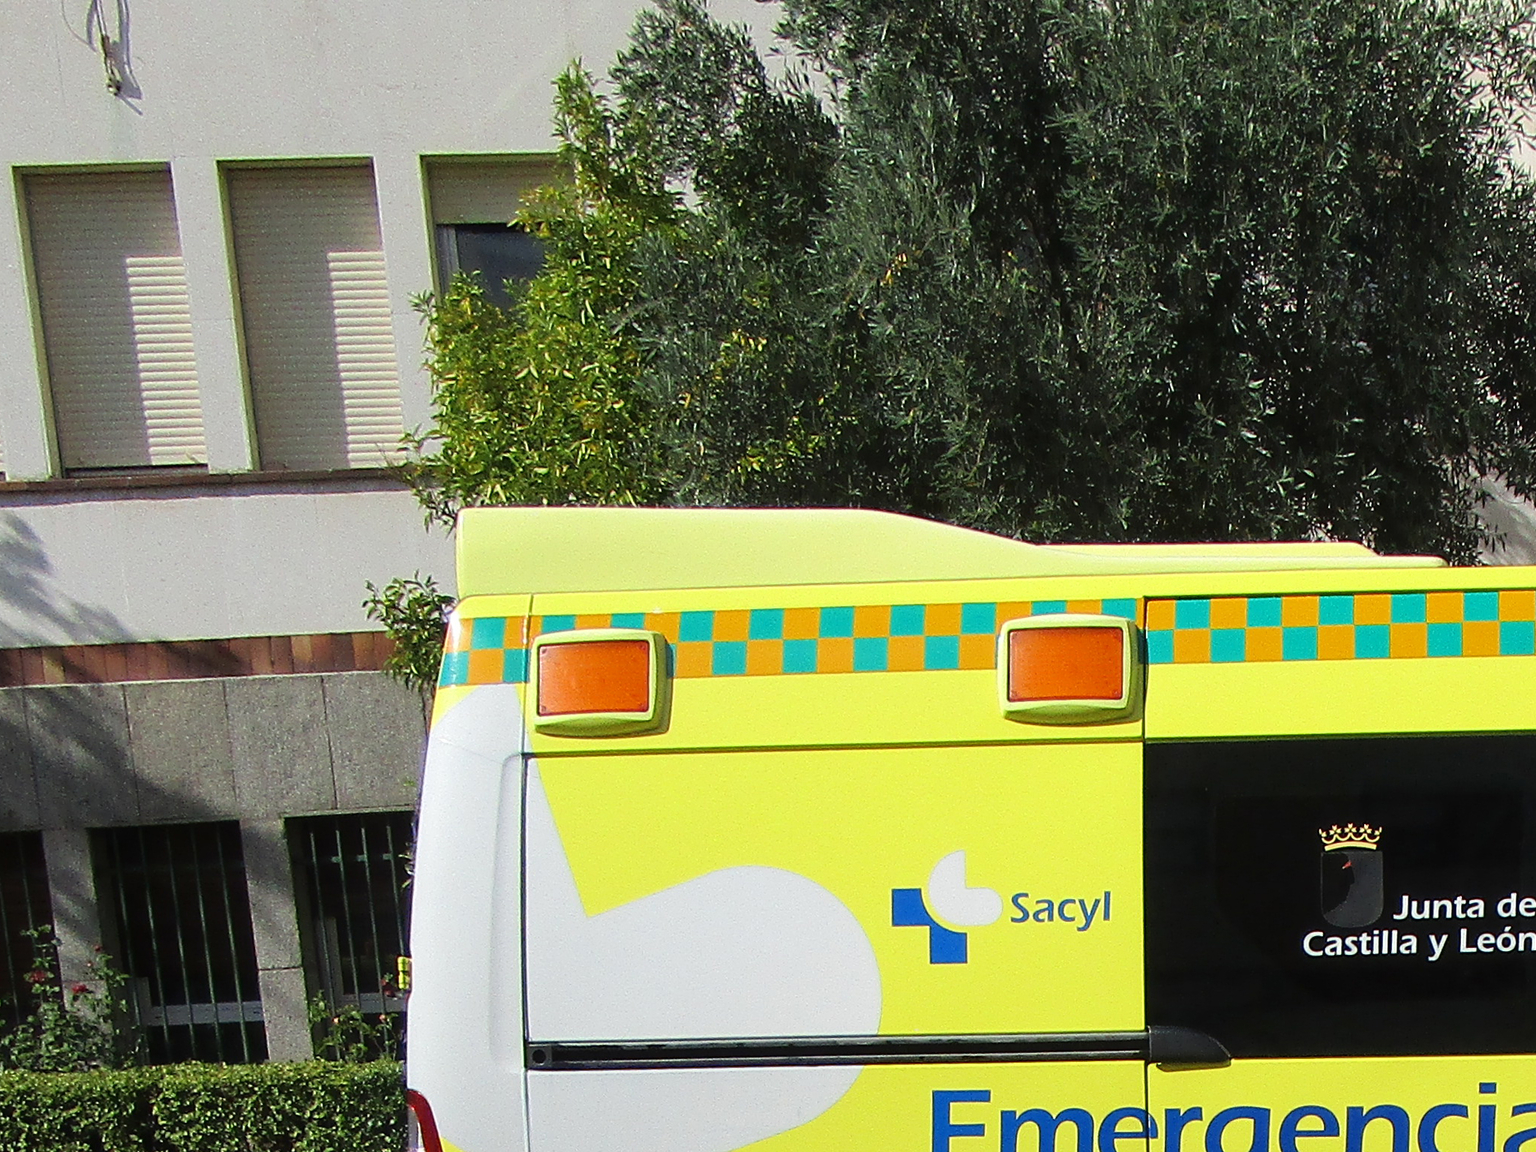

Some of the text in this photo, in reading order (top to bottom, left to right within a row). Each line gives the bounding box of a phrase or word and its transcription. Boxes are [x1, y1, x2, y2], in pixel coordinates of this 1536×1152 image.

[1010, 890, 1111, 931] Sacyl
[1393, 895, 1485, 920] Junta
[1302, 929, 1418, 957] Castilla
[1427, 934, 1449, 961] y
